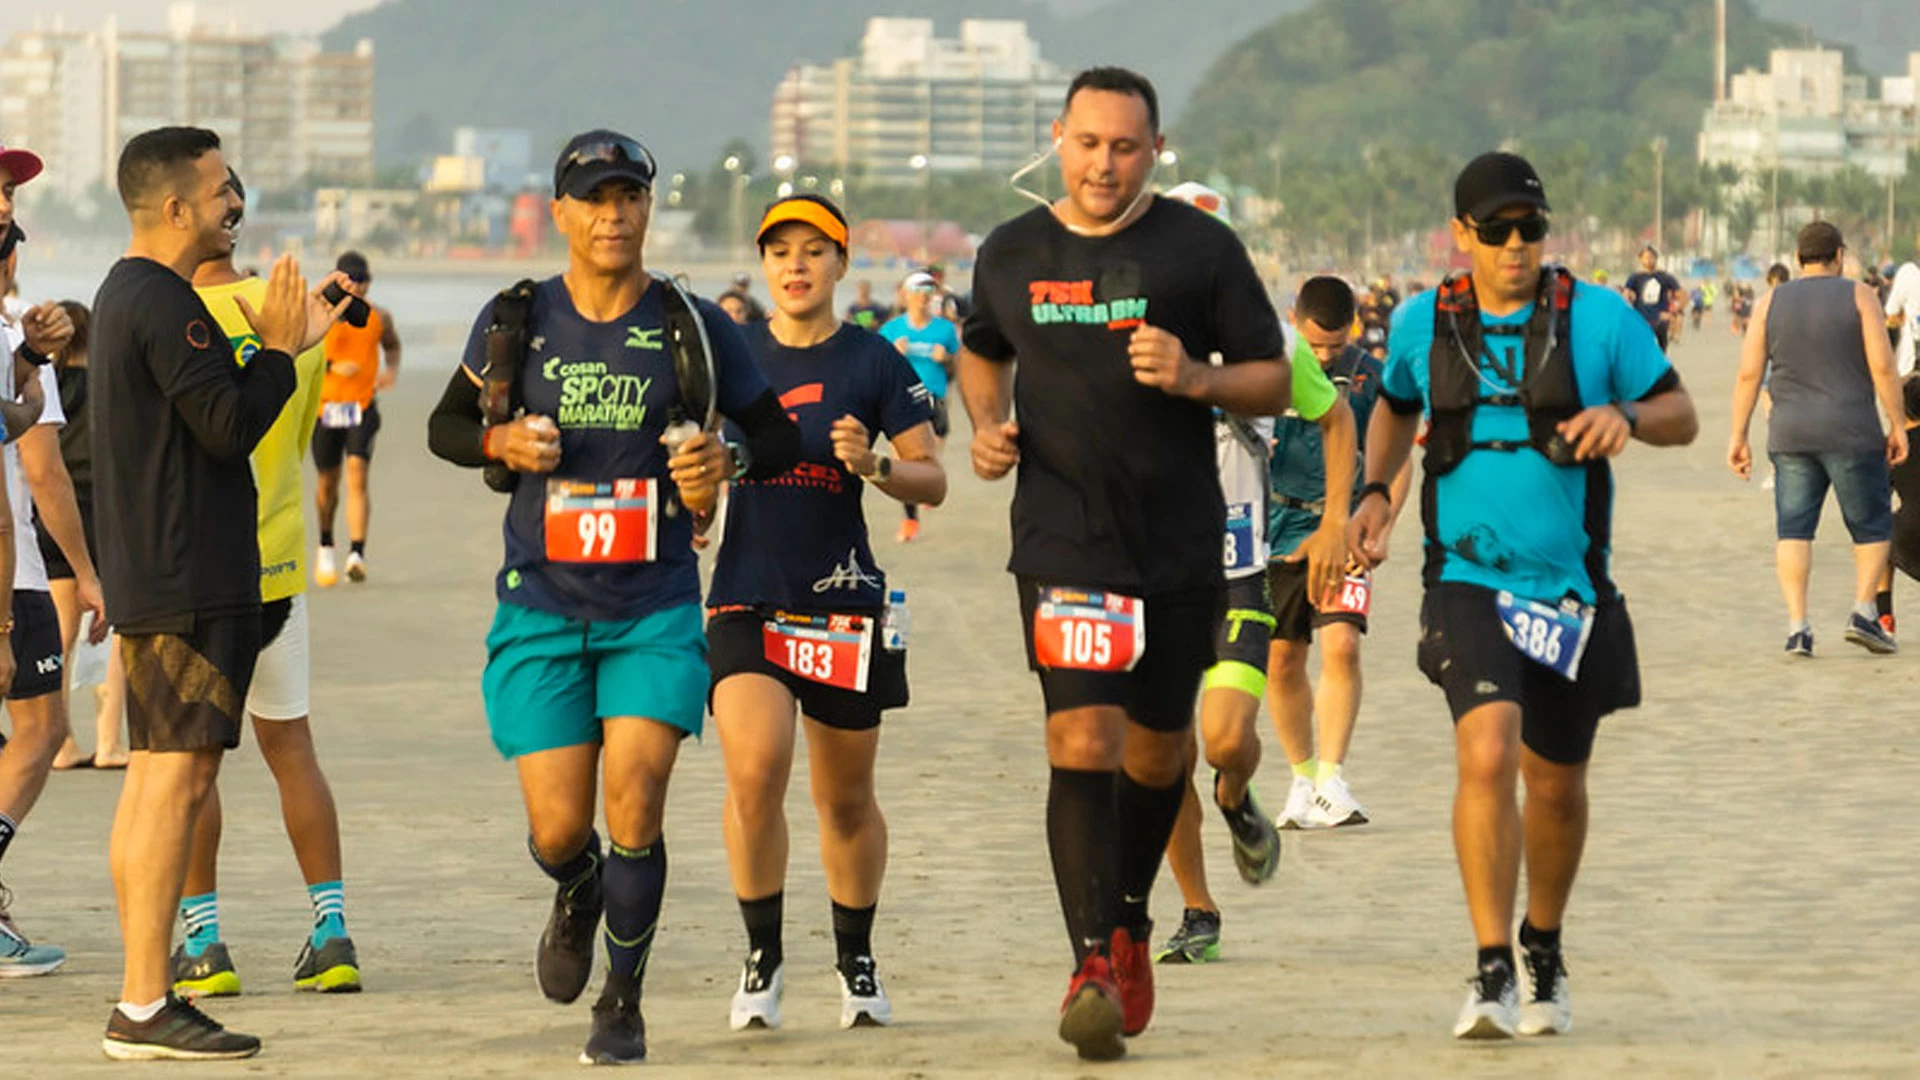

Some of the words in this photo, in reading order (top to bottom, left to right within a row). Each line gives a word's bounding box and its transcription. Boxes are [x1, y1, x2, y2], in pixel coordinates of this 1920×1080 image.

[1031, 303, 1109, 324] ULTRA
[560, 362, 607, 377] cosan
[558, 403, 646, 424] MARATHON
[578, 511, 616, 557] 99
[785, 638, 833, 679] 183
[1061, 619, 1112, 666] 105
[1513, 611, 1563, 665] 386
